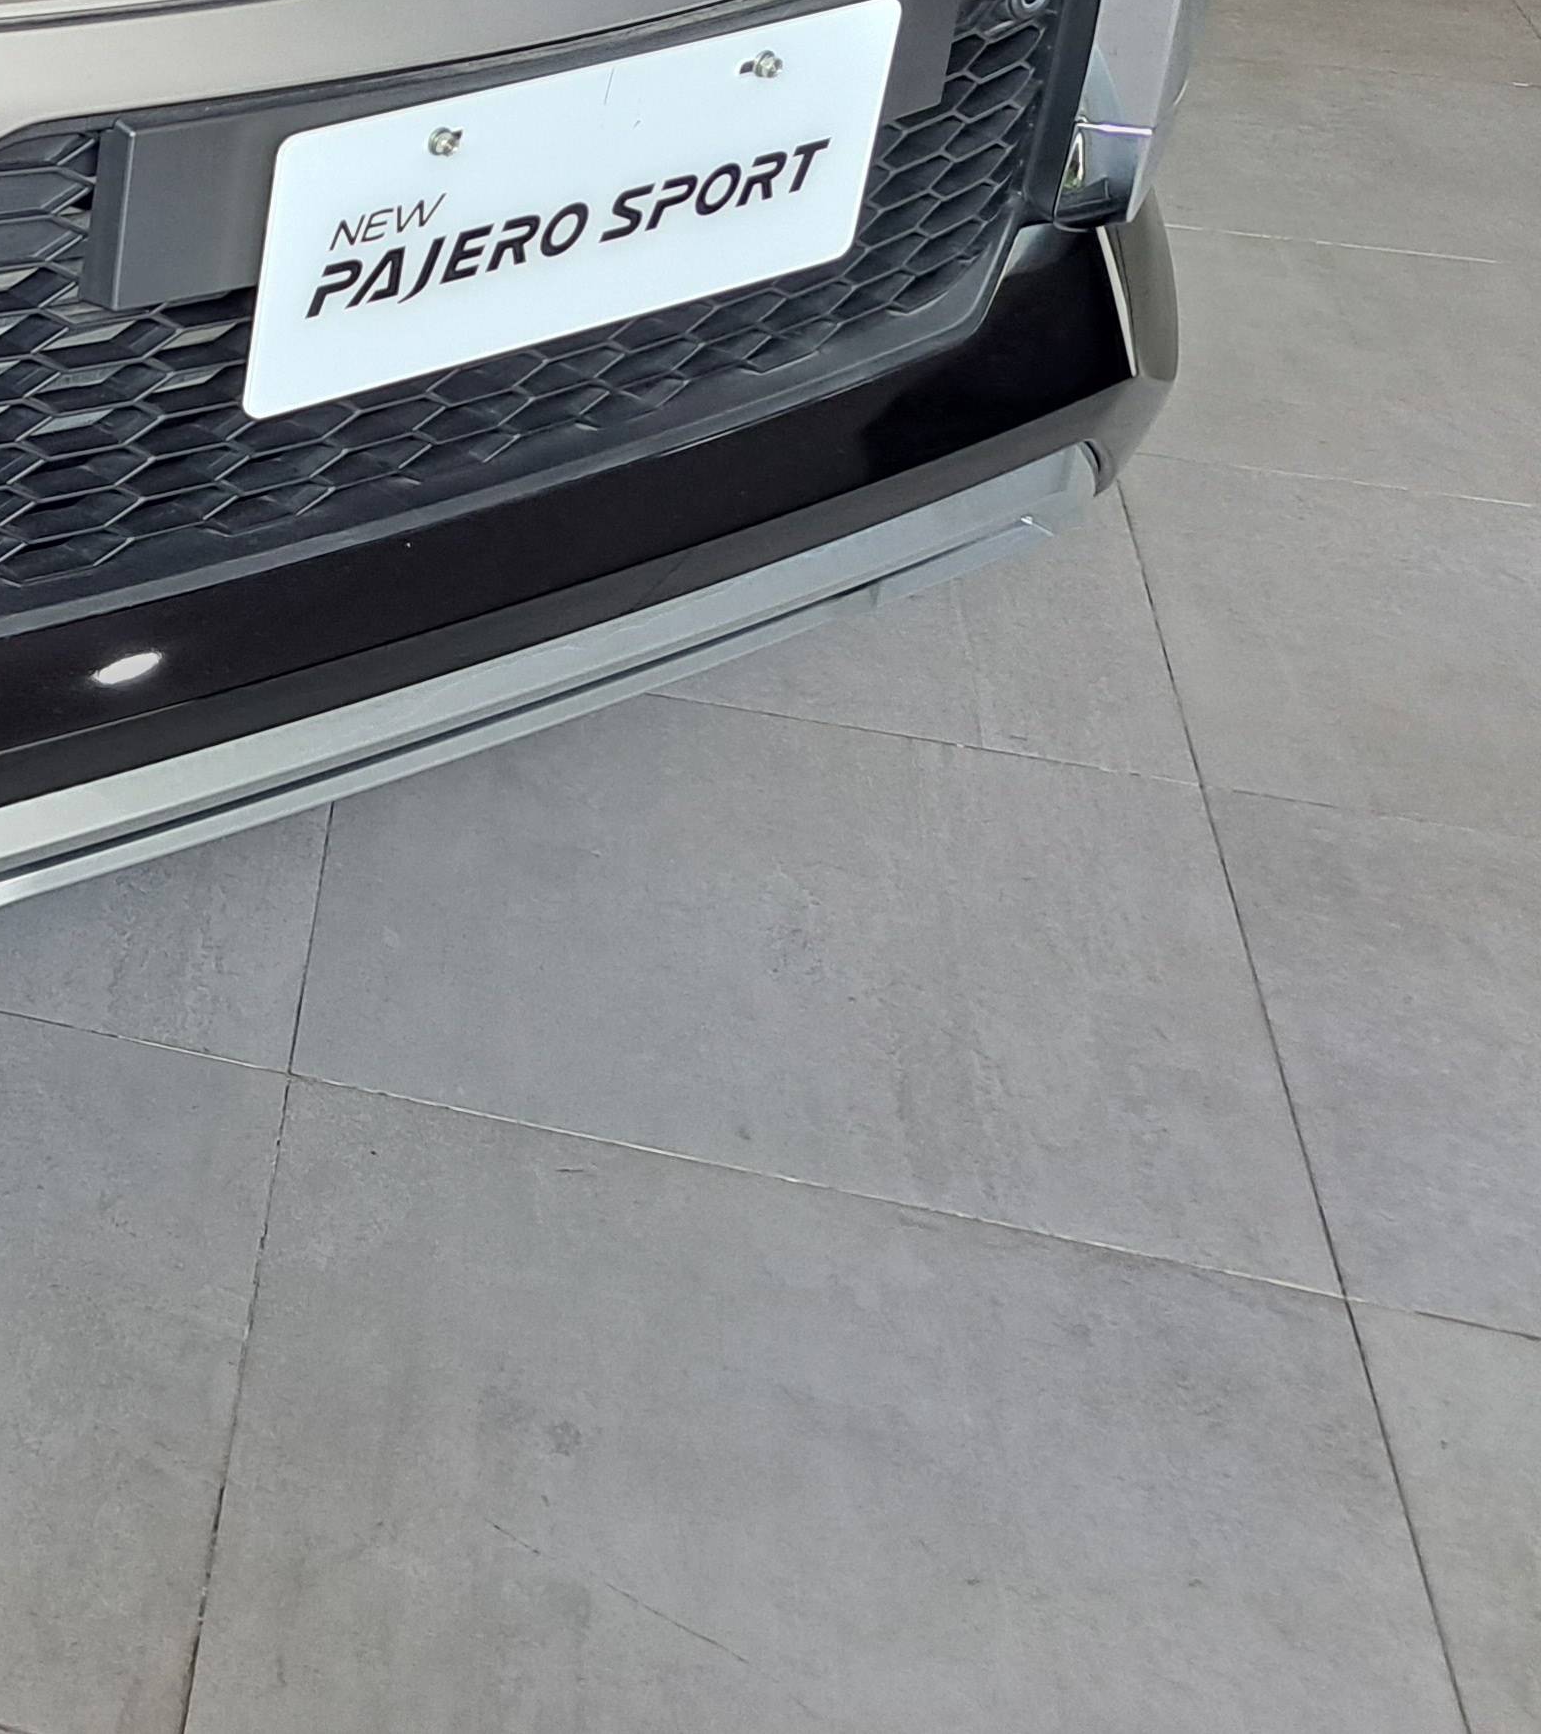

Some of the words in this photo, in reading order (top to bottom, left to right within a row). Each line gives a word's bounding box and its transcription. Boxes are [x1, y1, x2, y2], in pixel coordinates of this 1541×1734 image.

[305, 202, 590, 320] PAJERO
[599, 138, 831, 243] SPORT
[329, 192, 447, 252] NEW
